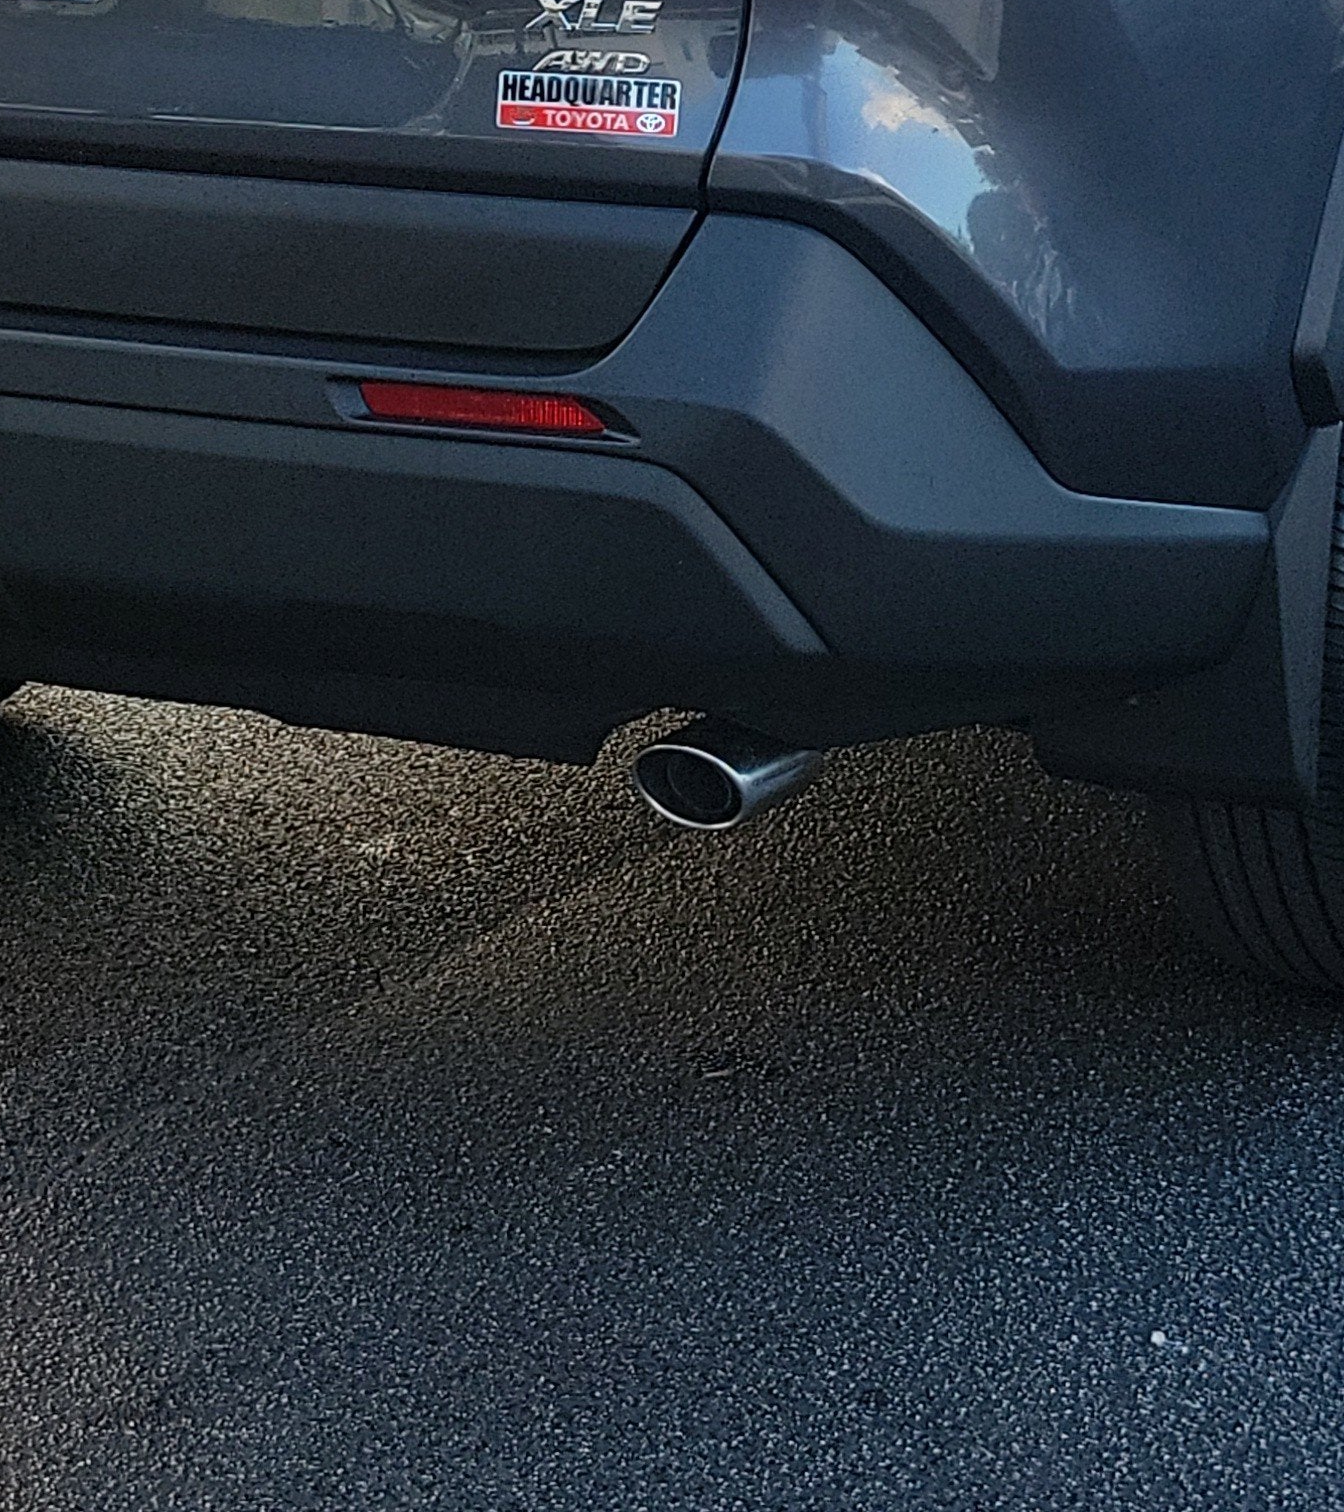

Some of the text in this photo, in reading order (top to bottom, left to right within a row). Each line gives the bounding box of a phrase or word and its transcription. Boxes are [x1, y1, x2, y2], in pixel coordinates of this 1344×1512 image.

[532, 49, 652, 75] AWD
[502, 74, 677, 110] HEADQUARTER
[543, 108, 629, 132] TOYOTA
